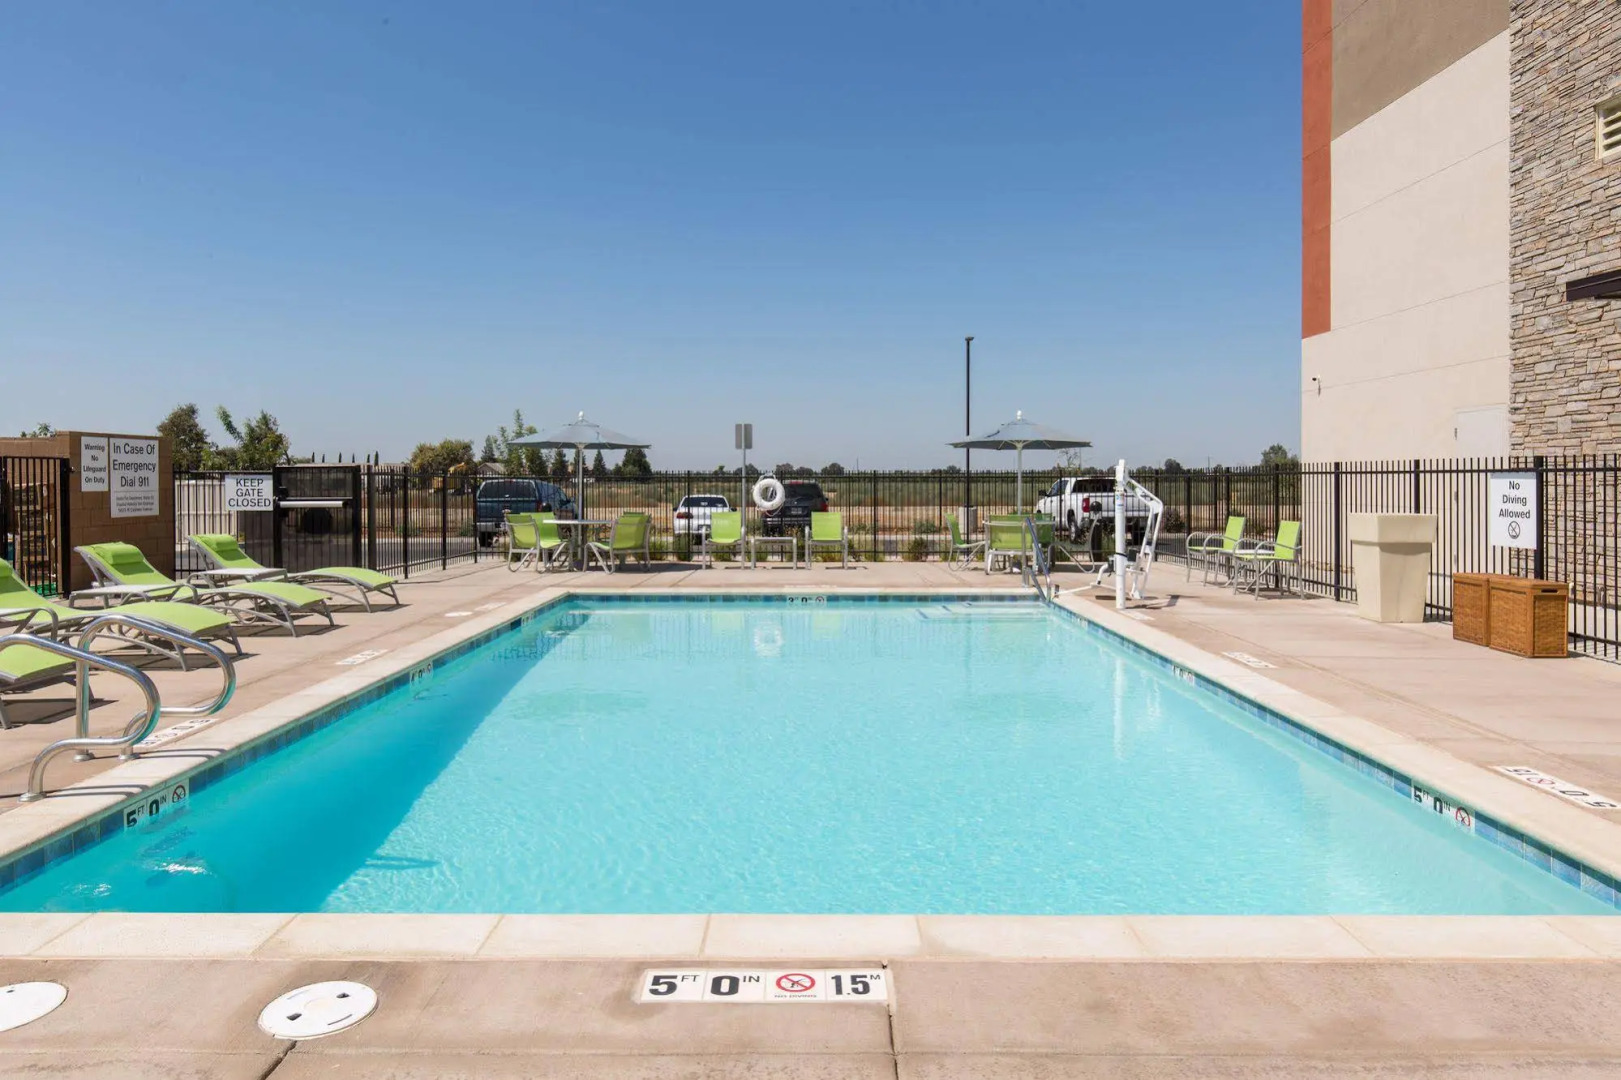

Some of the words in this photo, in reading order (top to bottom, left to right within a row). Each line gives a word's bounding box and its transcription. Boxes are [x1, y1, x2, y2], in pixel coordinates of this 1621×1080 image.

[84, 443, 105, 452] Warning
[113, 442, 121, 454] In
[123, 443, 144, 454] Case
[146, 444, 155, 455] Of
[83, 465, 107, 473] Lifeguard
[112, 459, 156, 473] Emergency
[84, 476, 93, 484] On
[94, 476, 105, 484] Duty
[120, 476, 136, 487] Dial
[138, 476, 150, 487] 911
[235, 478, 264, 487] KEEP
[1508, 480, 1520, 490] No
[235, 488, 264, 498] GATE
[228, 498, 271, 508] CLOSED
[1502, 494, 1527, 507] Diving
[1498, 508, 1531, 519] Allowed
